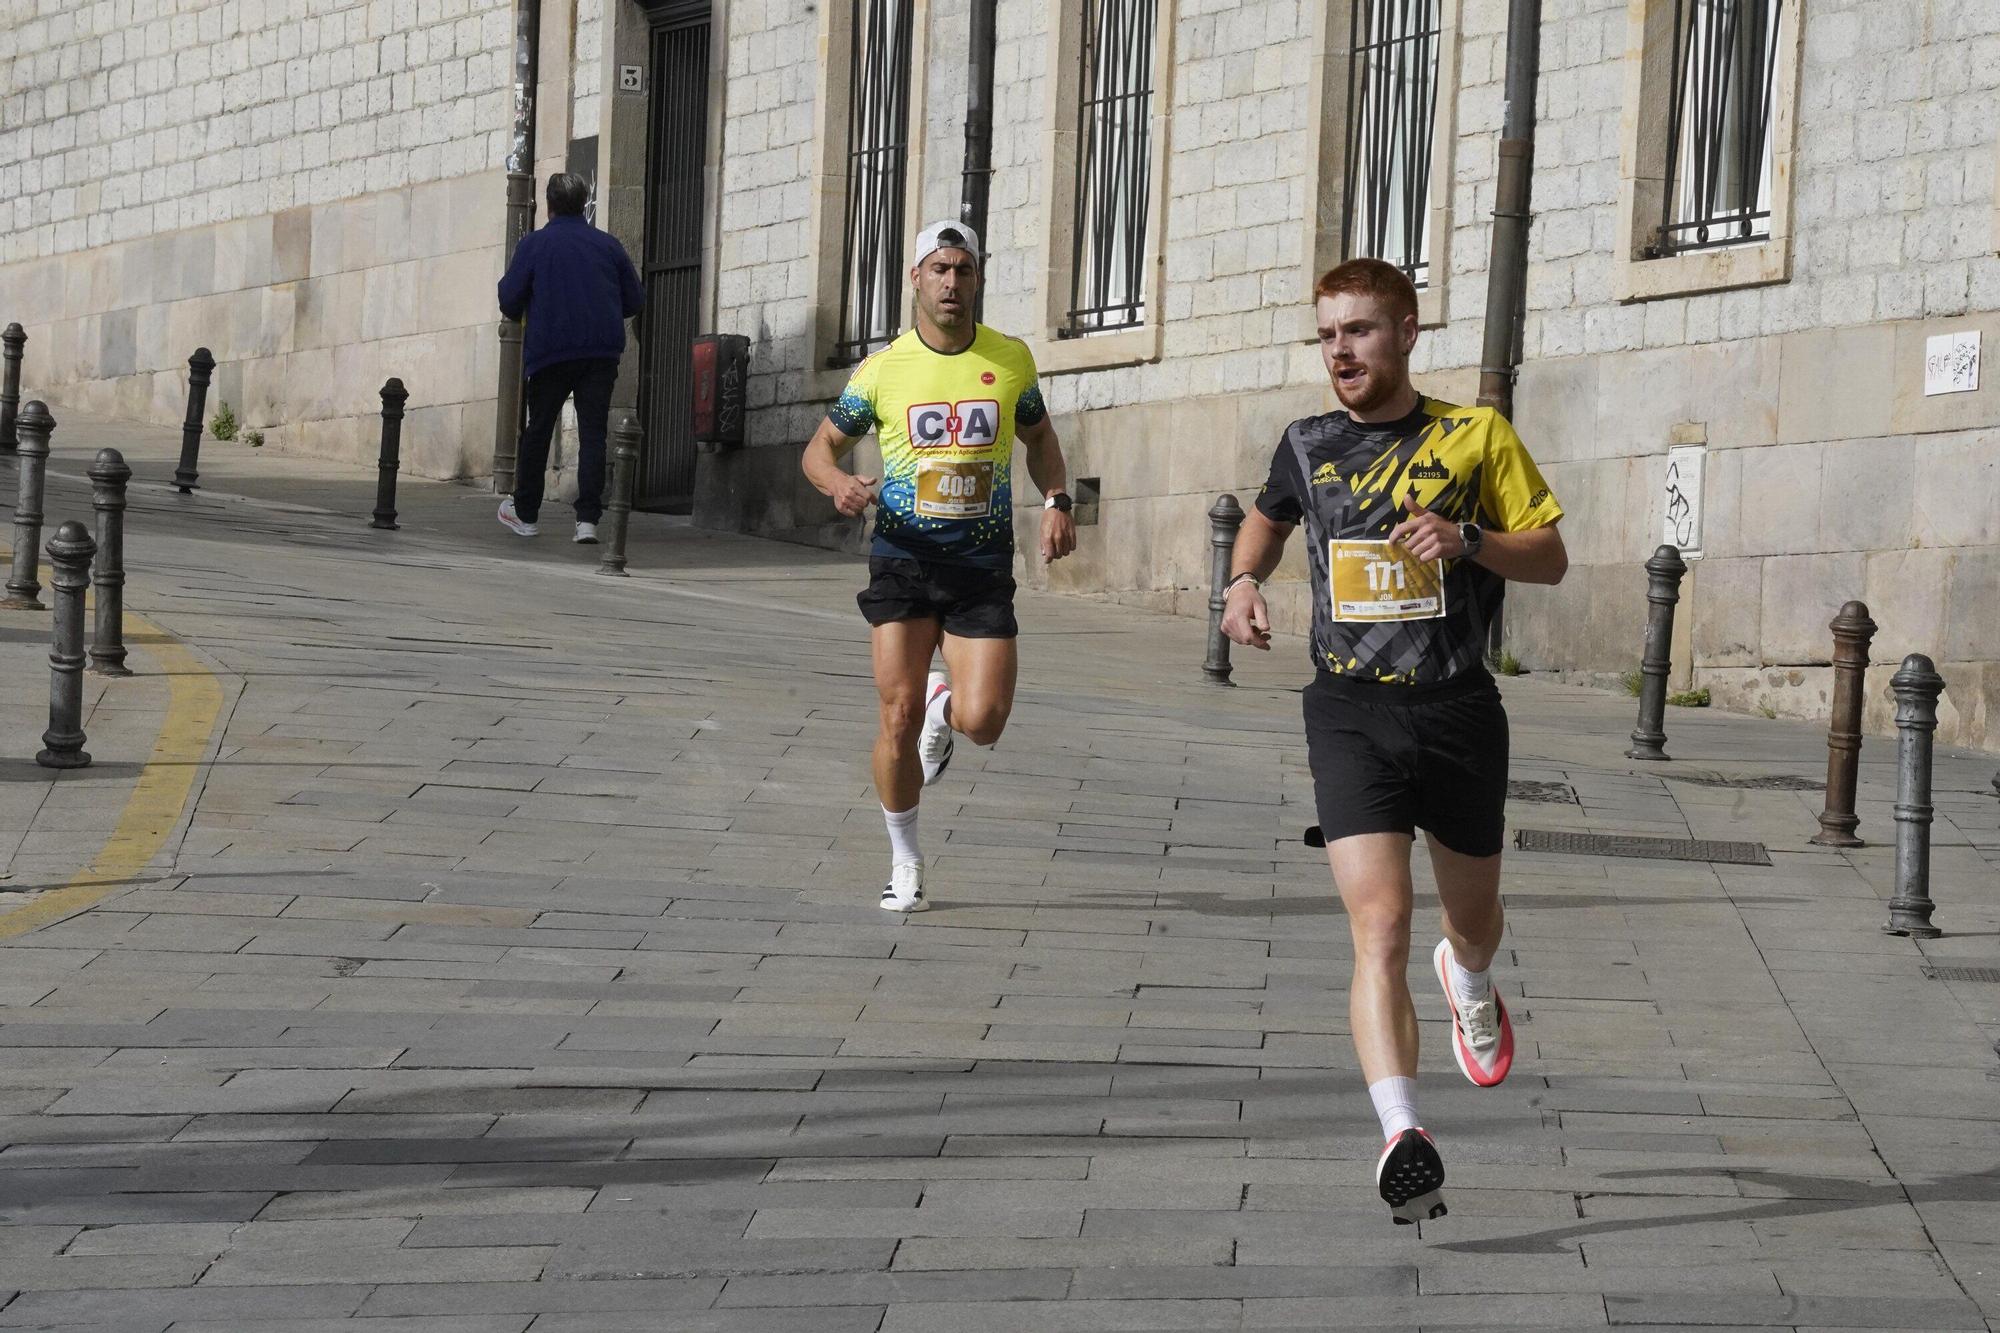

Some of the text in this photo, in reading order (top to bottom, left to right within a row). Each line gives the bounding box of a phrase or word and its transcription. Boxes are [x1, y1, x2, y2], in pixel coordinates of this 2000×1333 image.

[1417, 471, 1441, 479] 42195
[936, 475, 977, 497] 408
[1363, 560, 1405, 591] 171
[1379, 593, 1393, 601] JON
